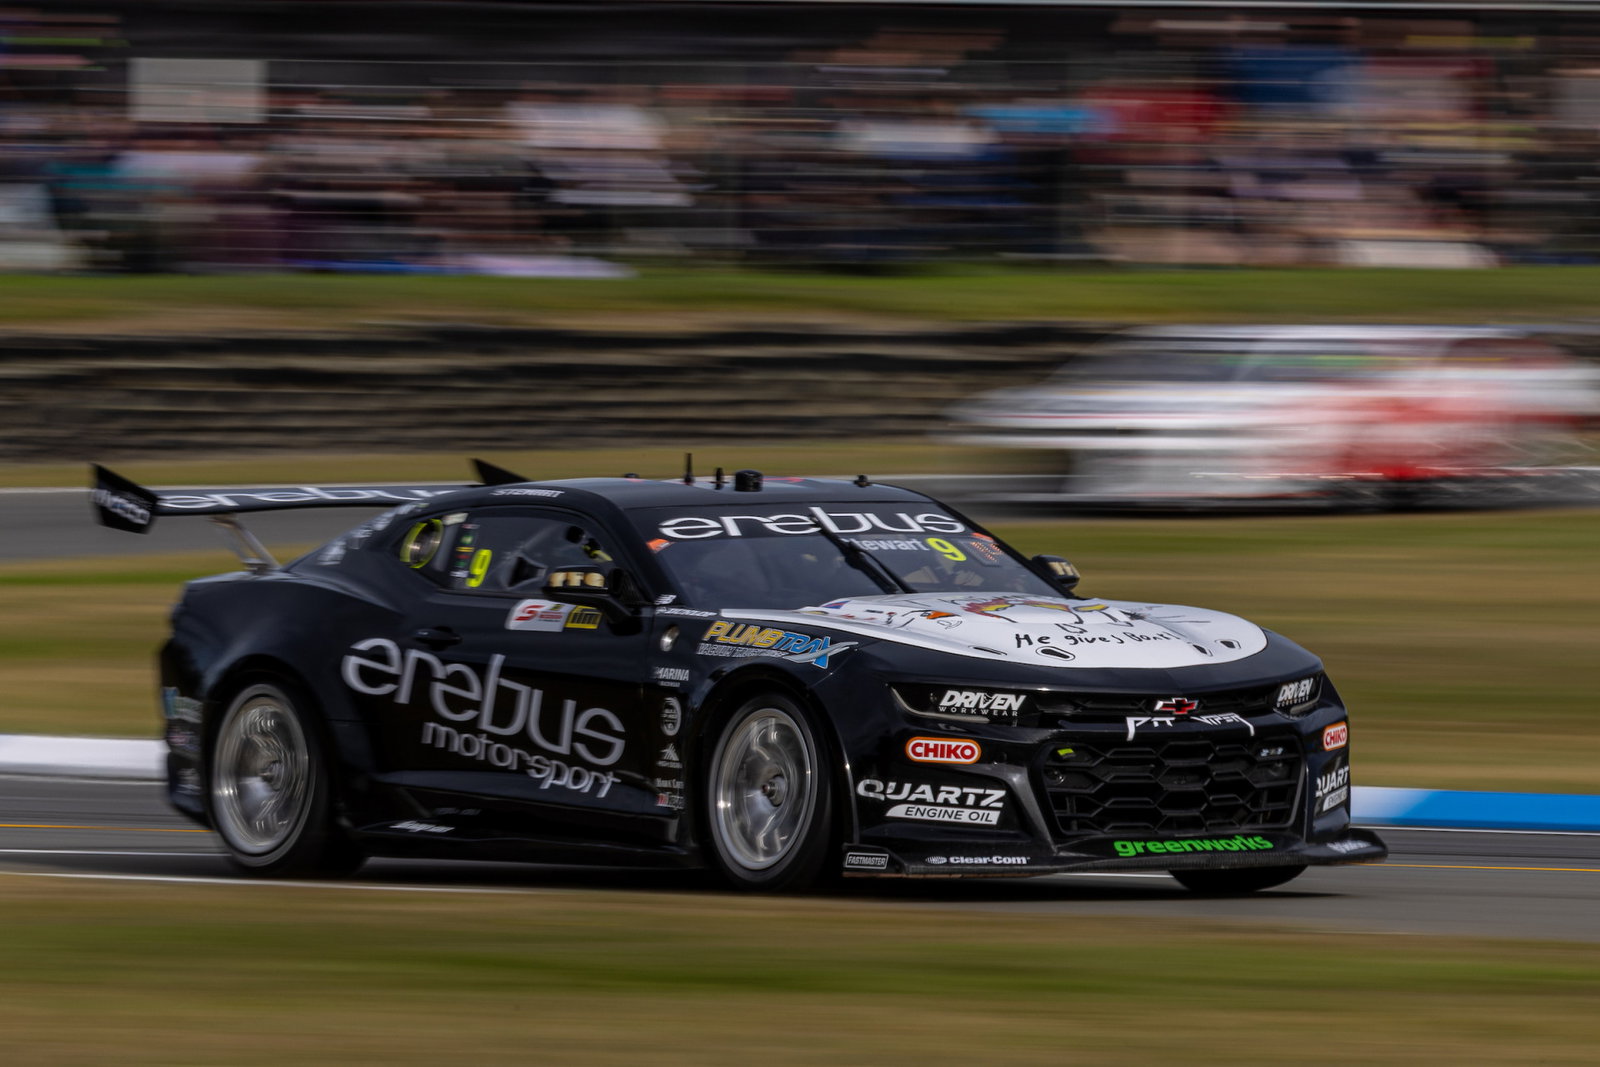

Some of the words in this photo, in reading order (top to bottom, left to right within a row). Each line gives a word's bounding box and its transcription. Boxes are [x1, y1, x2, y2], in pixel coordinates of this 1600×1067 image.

[659, 506, 966, 539] erebus
[840, 538, 931, 551] tewart
[925, 537, 967, 562] 9
[466, 549, 493, 587] 9
[702, 621, 858, 669] PLUMBTRAX
[1015, 633, 1051, 648] He
[1063, 634, 1124, 645] gives
[938, 690, 1027, 711] DRIVEN
[1277, 677, 1314, 703] DRIVEN
[341, 638, 626, 766] erebus
[938, 706, 1018, 717] WORKWEAR
[1324, 726, 1348, 748] CHIKO
[421, 721, 621, 798] motorsport
[910, 742, 977, 760] CHIKO
[856, 779, 1007, 808] QUARTZ
[904, 806, 965, 821] ENGINE
[968, 810, 994, 823] OIL
[1113, 834, 1274, 857] greenworks
[847, 856, 886, 866] FASTMASTER
[949, 855, 1028, 865] Clear-Com
